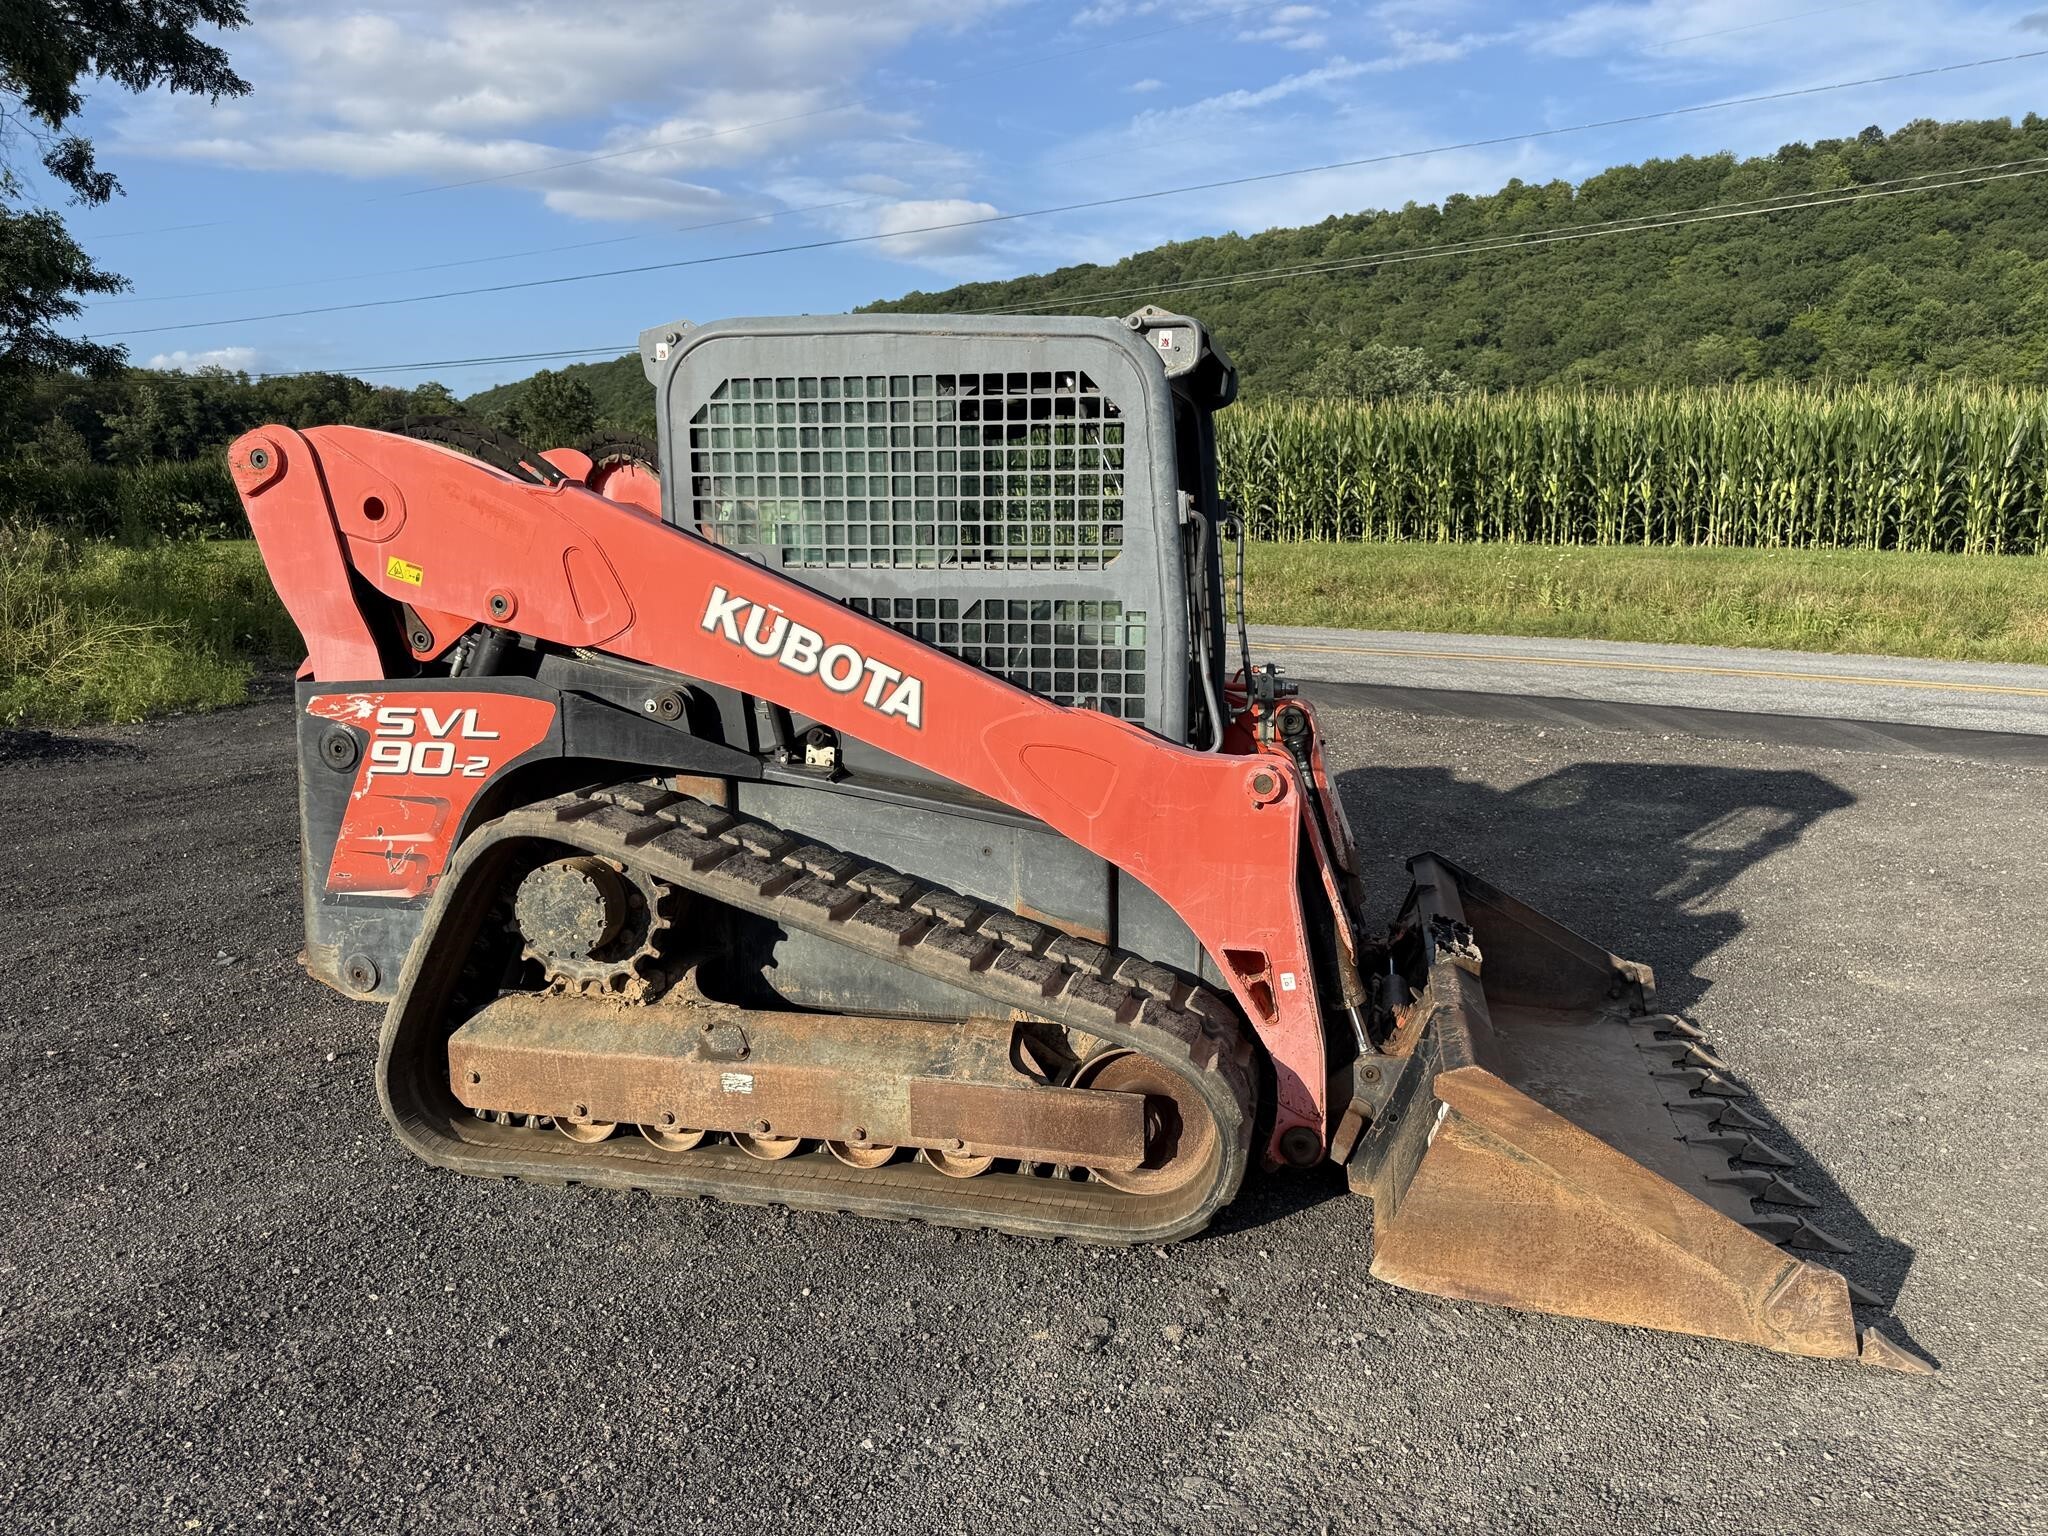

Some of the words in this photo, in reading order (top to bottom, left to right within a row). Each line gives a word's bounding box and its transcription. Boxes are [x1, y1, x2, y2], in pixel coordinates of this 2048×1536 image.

[701, 586, 922, 728] KUBOTA
[374, 707, 499, 739] SVL
[368, 740, 490, 777] 90-2
